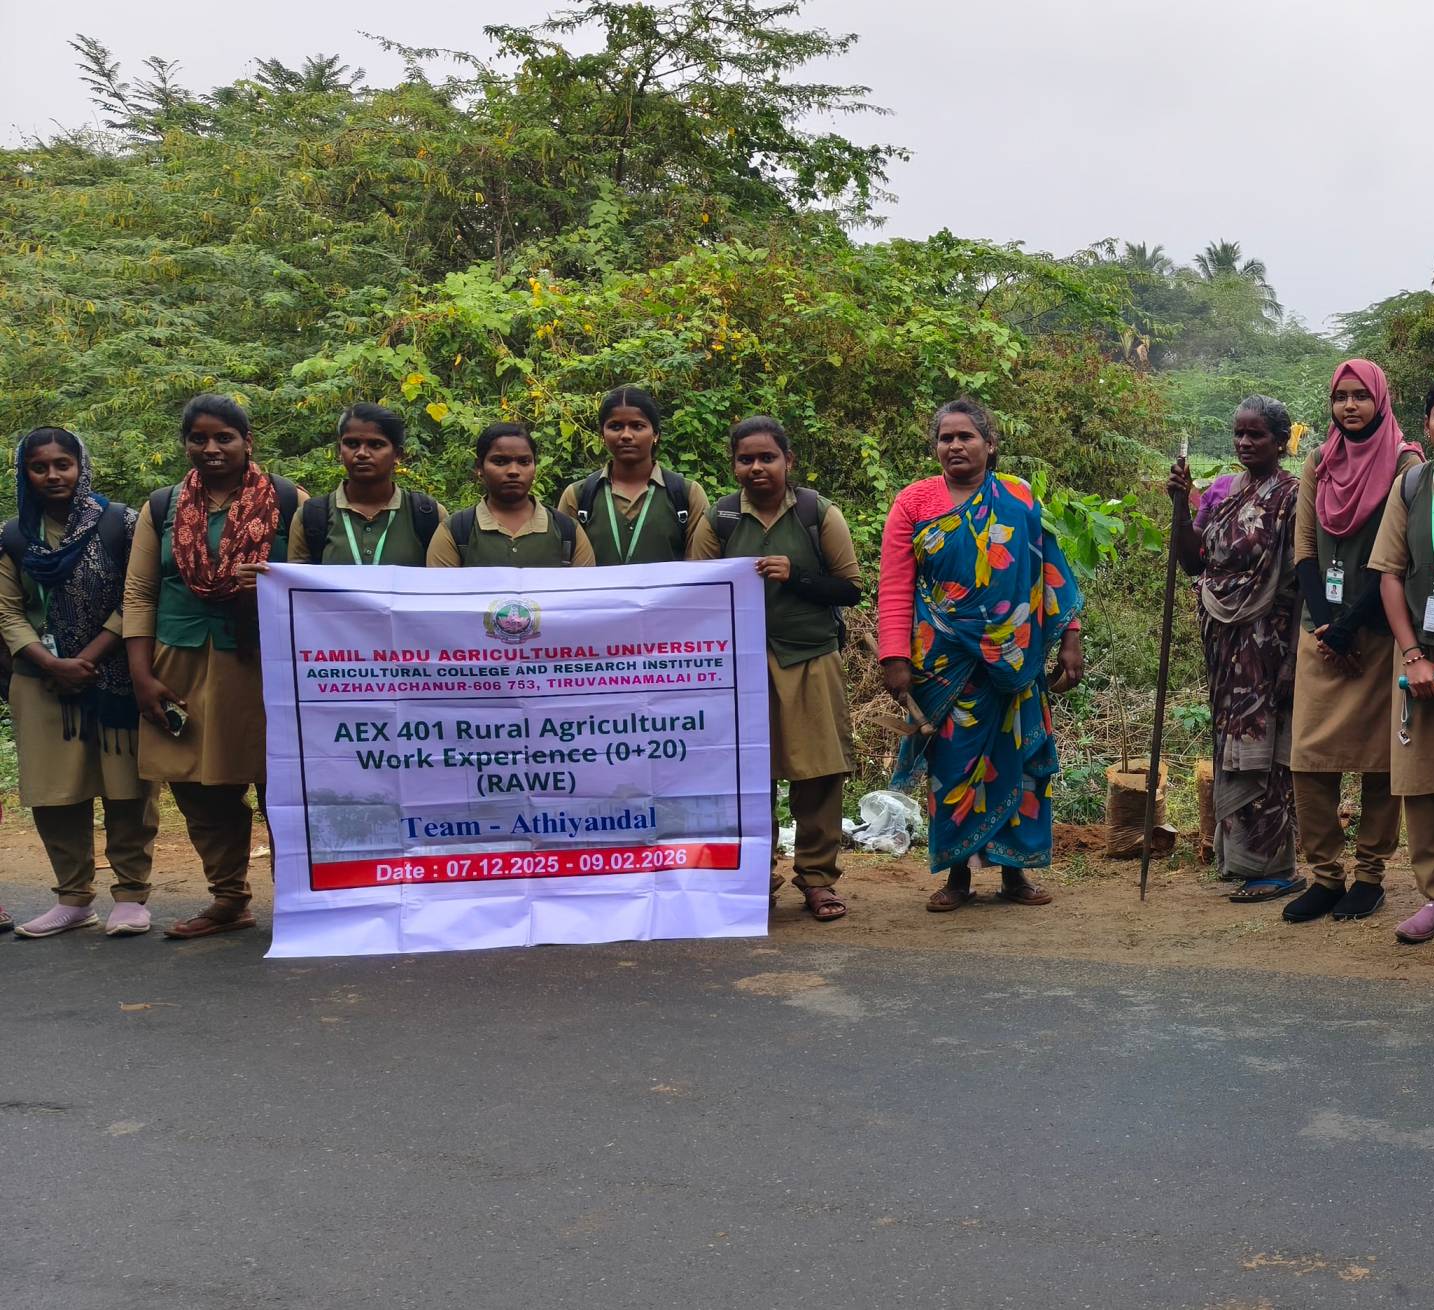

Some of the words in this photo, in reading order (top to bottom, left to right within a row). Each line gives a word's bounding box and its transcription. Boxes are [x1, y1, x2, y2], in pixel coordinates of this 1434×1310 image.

[299, 649, 366, 662] TAMIL
[373, 649, 430, 662] NADU
[438, 646, 600, 662] AGRICULTURAL
[607, 640, 729, 656] UNIVERSITY
[307, 667, 431, 678] AGRICULTURAL
[437, 666, 510, 677] COLLEGE
[516, 665, 548, 675] AND
[553, 661, 637, 673] RESEARCH
[642, 658, 724, 669] INSTITUTE
[318, 681, 501, 693] VAZHAVACHANUR-606
[507, 680, 541, 691] 753,
[546, 673, 691, 688] TIRUVANNAMALAI
[697, 672, 723, 682] DT.
[334, 721, 390, 742] AEX
[397, 720, 445, 741] 401
[457, 718, 530, 740] Rural
[539, 710, 705, 742] Agricultural
[356, 748, 434, 770] Work
[444, 746, 598, 772] Experience
[606, 739, 687, 766] (0+20)
[476, 771, 577, 797] (RAWE)
[401, 816, 481, 839] Team
[510, 807, 657, 838] Athiyandal
[376, 864, 425, 881] Date
[446, 856, 560, 877] 07.12.2025
[580, 849, 688, 872] 09.02.2026
